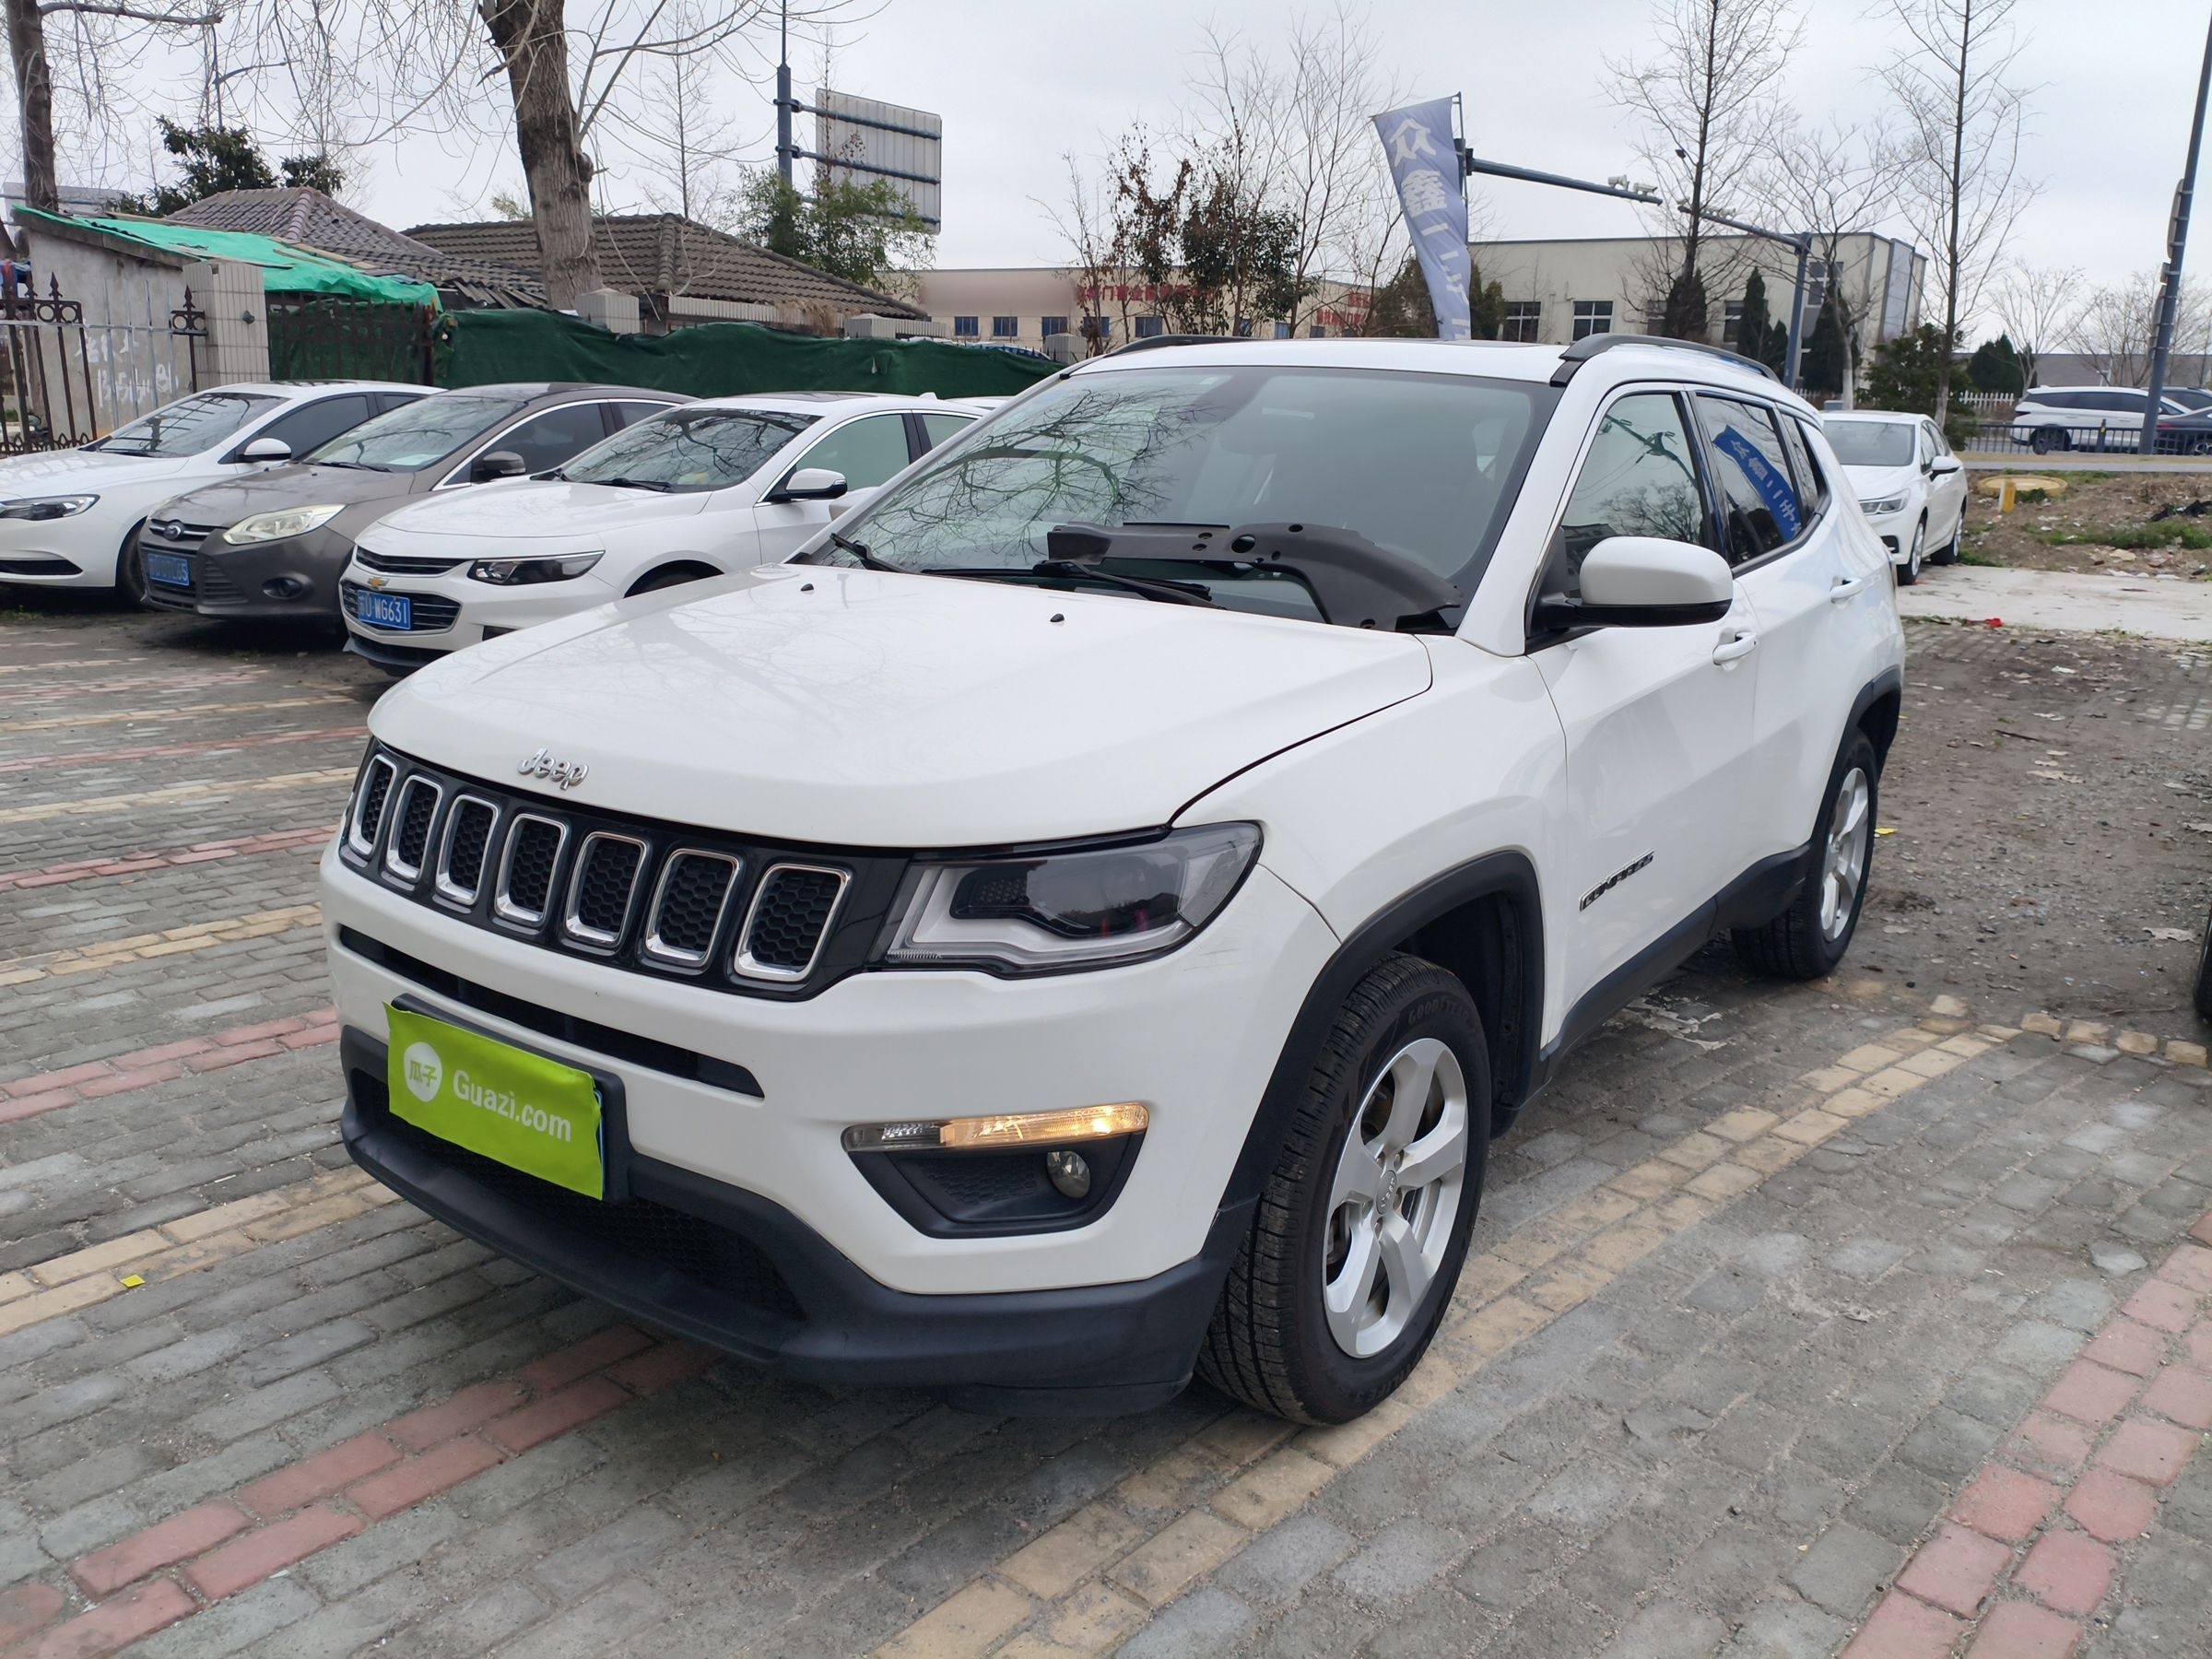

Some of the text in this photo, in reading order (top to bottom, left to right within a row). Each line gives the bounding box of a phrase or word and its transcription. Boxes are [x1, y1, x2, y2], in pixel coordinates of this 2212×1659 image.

[517, 747, 589, 791] Jeep
[408, 1060, 437, 1088] 瓜子
[453, 1070, 572, 1143] Guazi.com
